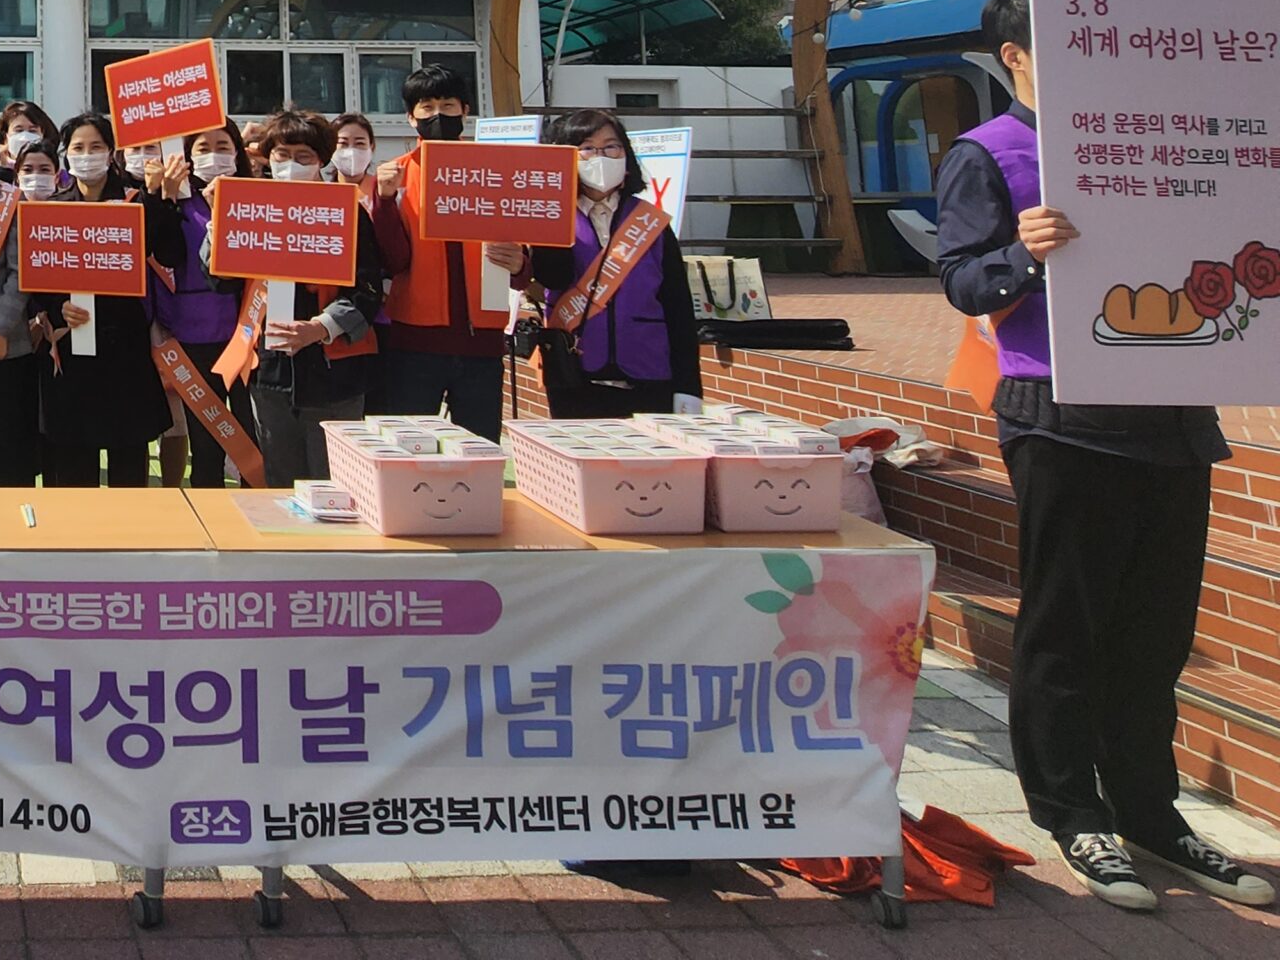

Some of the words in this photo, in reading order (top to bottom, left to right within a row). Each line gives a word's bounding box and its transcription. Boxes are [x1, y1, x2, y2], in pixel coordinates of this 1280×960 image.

[1067, 26, 1120, 59] 세계
[1129, 27, 1205, 61] 여성의
[1213, 29, 1278, 63] 날은?
[117, 76, 161, 100] 사라지는
[161, 63, 208, 89] 여성폭력
[120, 101, 165, 126] 살아나는
[165, 89, 212, 115] 인권존중
[1072, 112, 1105, 133] 여성
[1112, 112, 1165, 135] 운동의
[1171, 113, 1220, 136] 역사를
[1225, 118, 1268, 136] 기리고
[1074, 144, 1143, 167] 성평등한
[1151, 145, 1229, 167] 세상으로의
[434, 166, 503, 189] 사라지는
[512, 168, 563, 191] 성폭력
[1076, 175, 1148, 197] 촉구하는
[1153, 175, 1217, 199] 날입니다!
[226, 202, 285, 223] 사라지는
[287, 204, 346, 227] 여성폭력
[434, 194, 496, 218] 살아나는
[499, 196, 562, 220] 인권존중
[29, 225, 79, 244] 사라지는
[81, 226, 133, 245] 여성폭력
[225, 230, 283, 252] 살아나는
[285, 232, 345, 255] 인권존중
[601, 213, 659, 279] 사라지는
[29, 251, 79, 270] 살아나는
[82, 251, 134, 272] 인권존중
[158, 590, 277, 632] 남해와
[288, 589, 444, 629] 함께하는
[288, 665, 380, 763] 날
[401, 663, 574, 759] 기념
[602, 656, 865, 760] 캠페인
[179, 806, 242, 838] 장소
[263, 793, 590, 841] 남해읍행정복지센터
[604, 792, 747, 832] 야외무대
[760, 793, 797, 830] 앞
